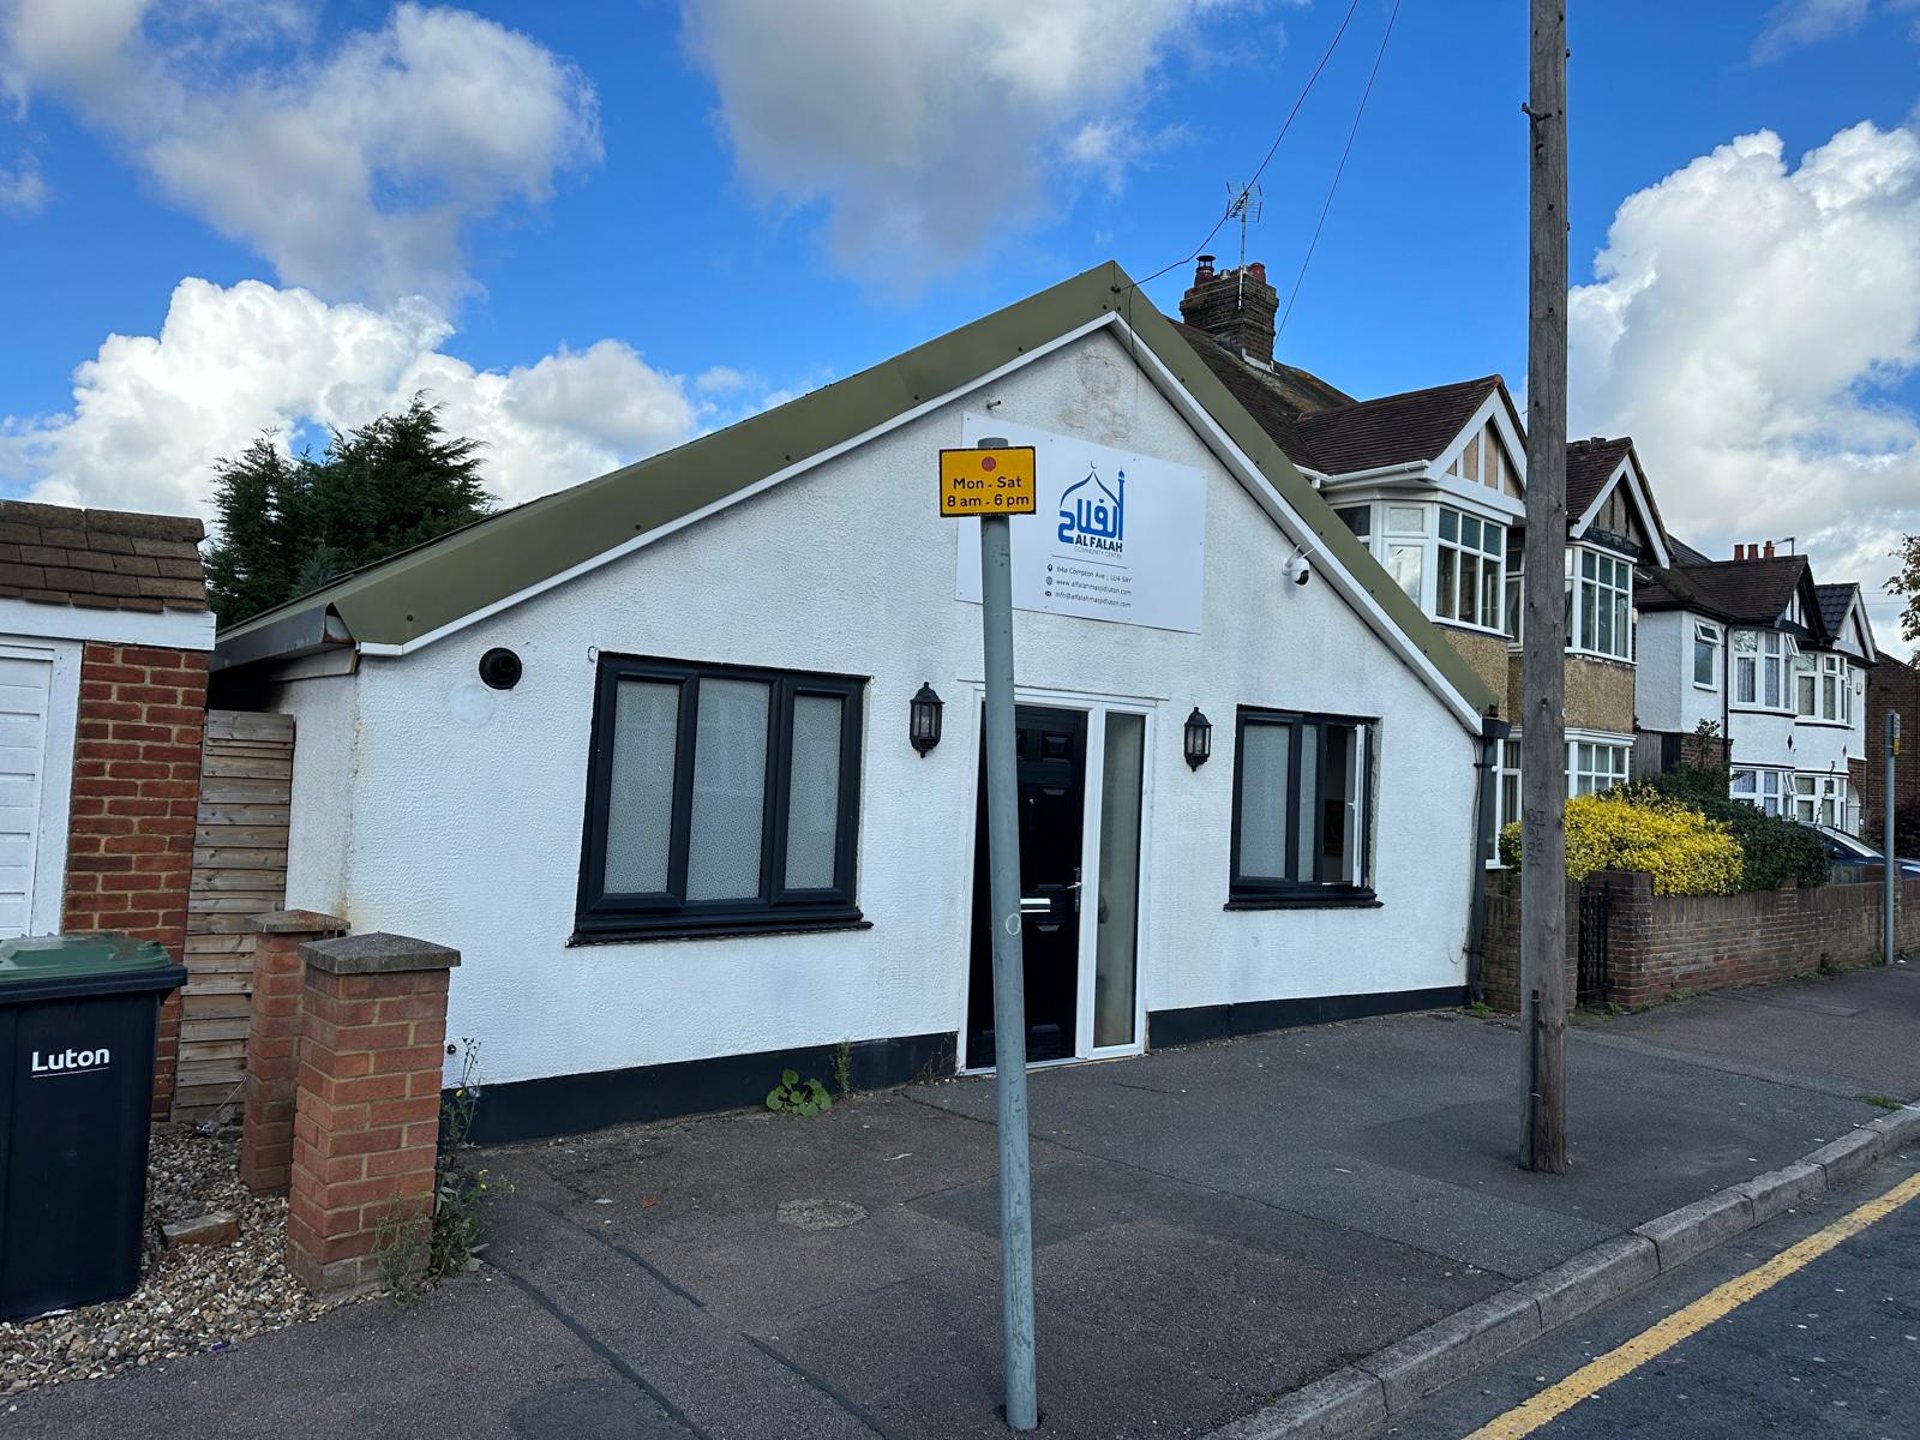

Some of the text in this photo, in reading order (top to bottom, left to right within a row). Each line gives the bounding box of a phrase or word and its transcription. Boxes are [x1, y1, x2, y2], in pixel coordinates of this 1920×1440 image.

[953, 478, 984, 490] Mon
[997, 476, 1022, 489] Sat
[947, 495, 956, 507] 8
[960, 497, 982, 507] am
[994, 494, 1003, 506] 6
[1007, 495, 1029, 507] pm
[1058, 479, 1124, 544] الفلاح
[1075, 534, 1123, 553] AL FALAH
[1069, 568, 1094, 578] Compton
[32, 1048, 110, 1072] Luton
